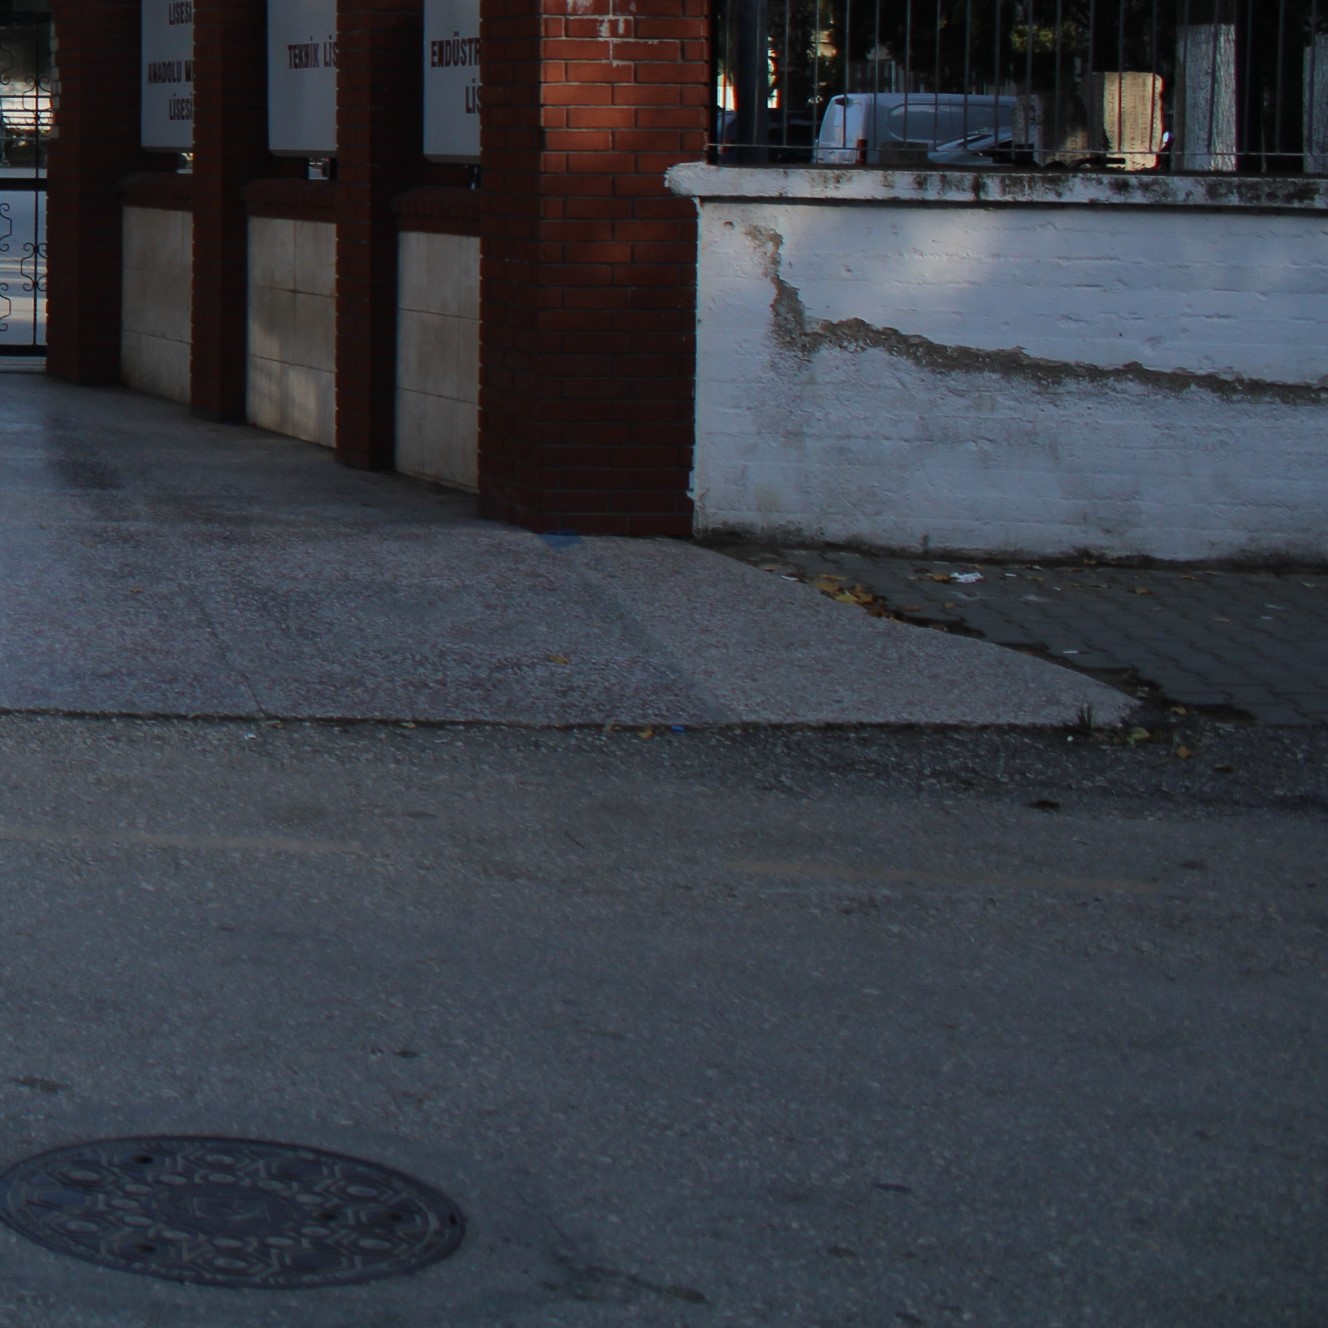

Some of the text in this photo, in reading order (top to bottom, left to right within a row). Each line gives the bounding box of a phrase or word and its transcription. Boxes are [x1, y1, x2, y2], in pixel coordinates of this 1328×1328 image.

[288, 36, 320, 69] TEKNİK
[148, 61, 182, 84] ANADOLU
[169, 93, 192, 120] LİSESİ
